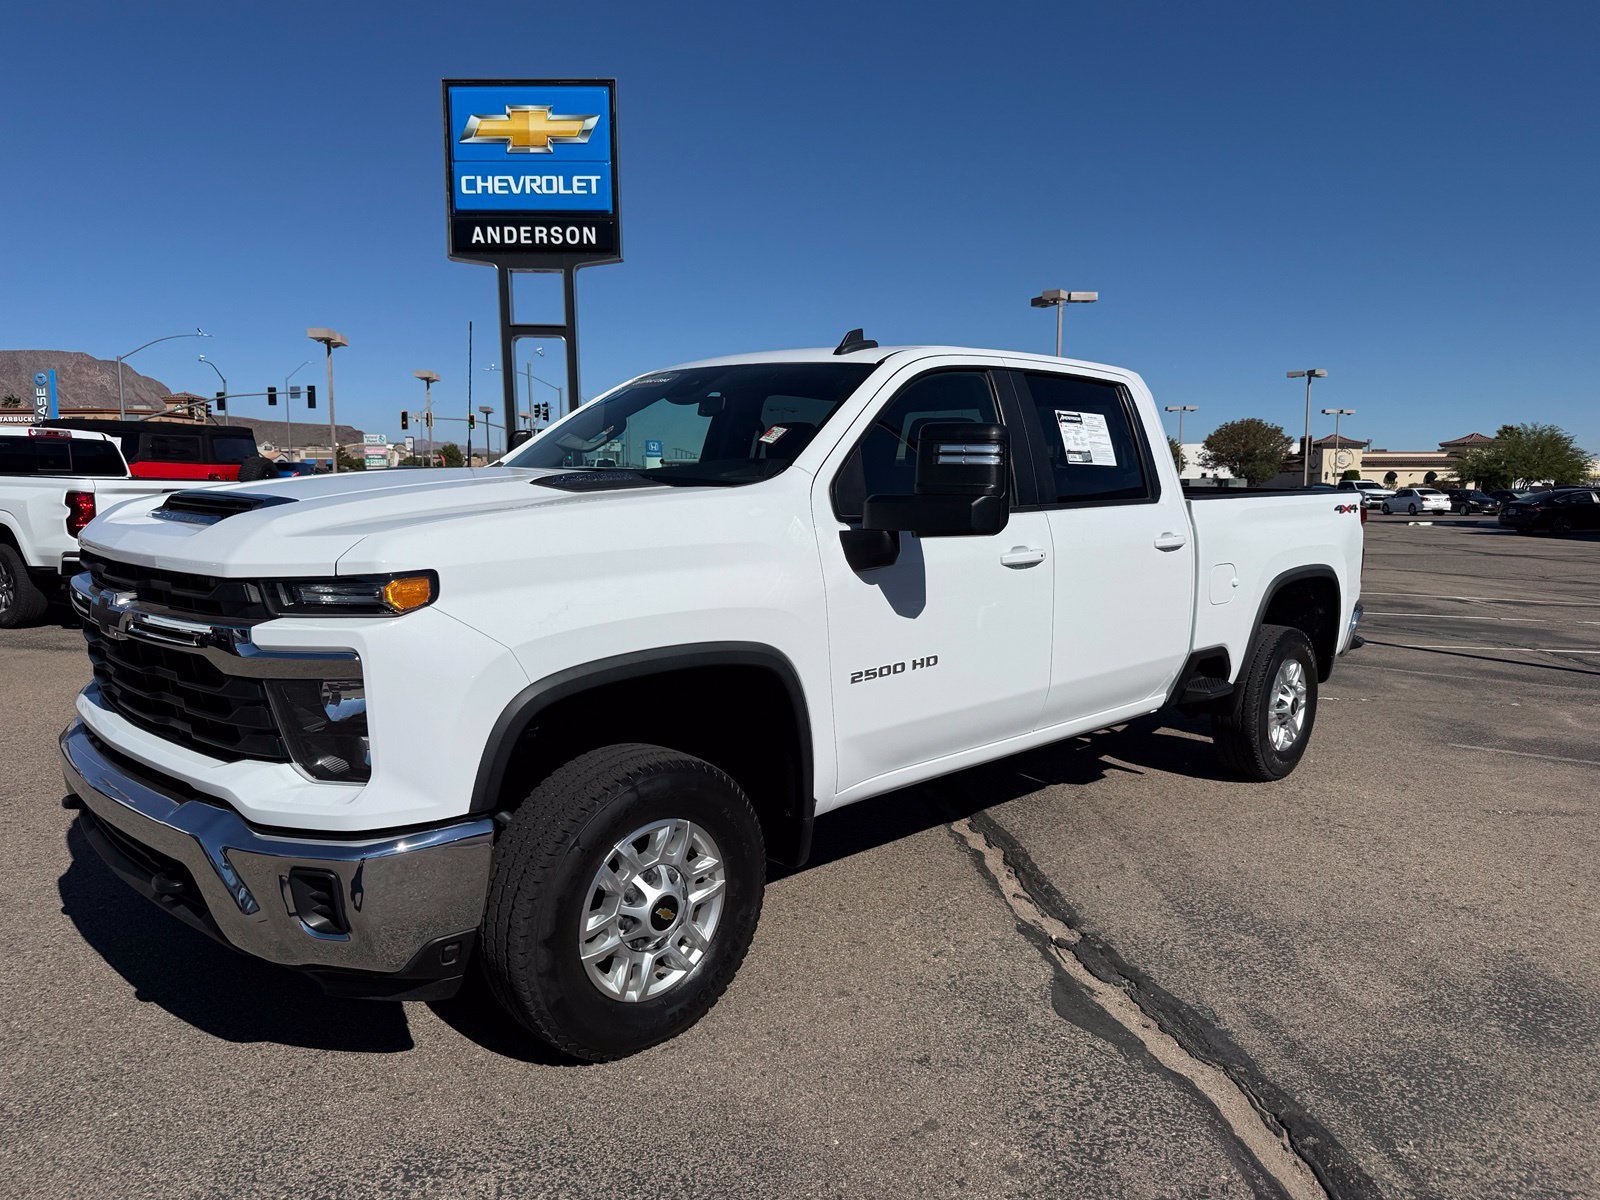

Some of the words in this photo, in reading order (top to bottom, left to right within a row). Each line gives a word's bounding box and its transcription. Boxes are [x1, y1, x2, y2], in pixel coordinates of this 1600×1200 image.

[461, 175, 601, 194] CHEVROLET
[471, 226, 597, 244] ANDERSON
[850, 662, 906, 684] 2500
[911, 655, 938, 670] HD
